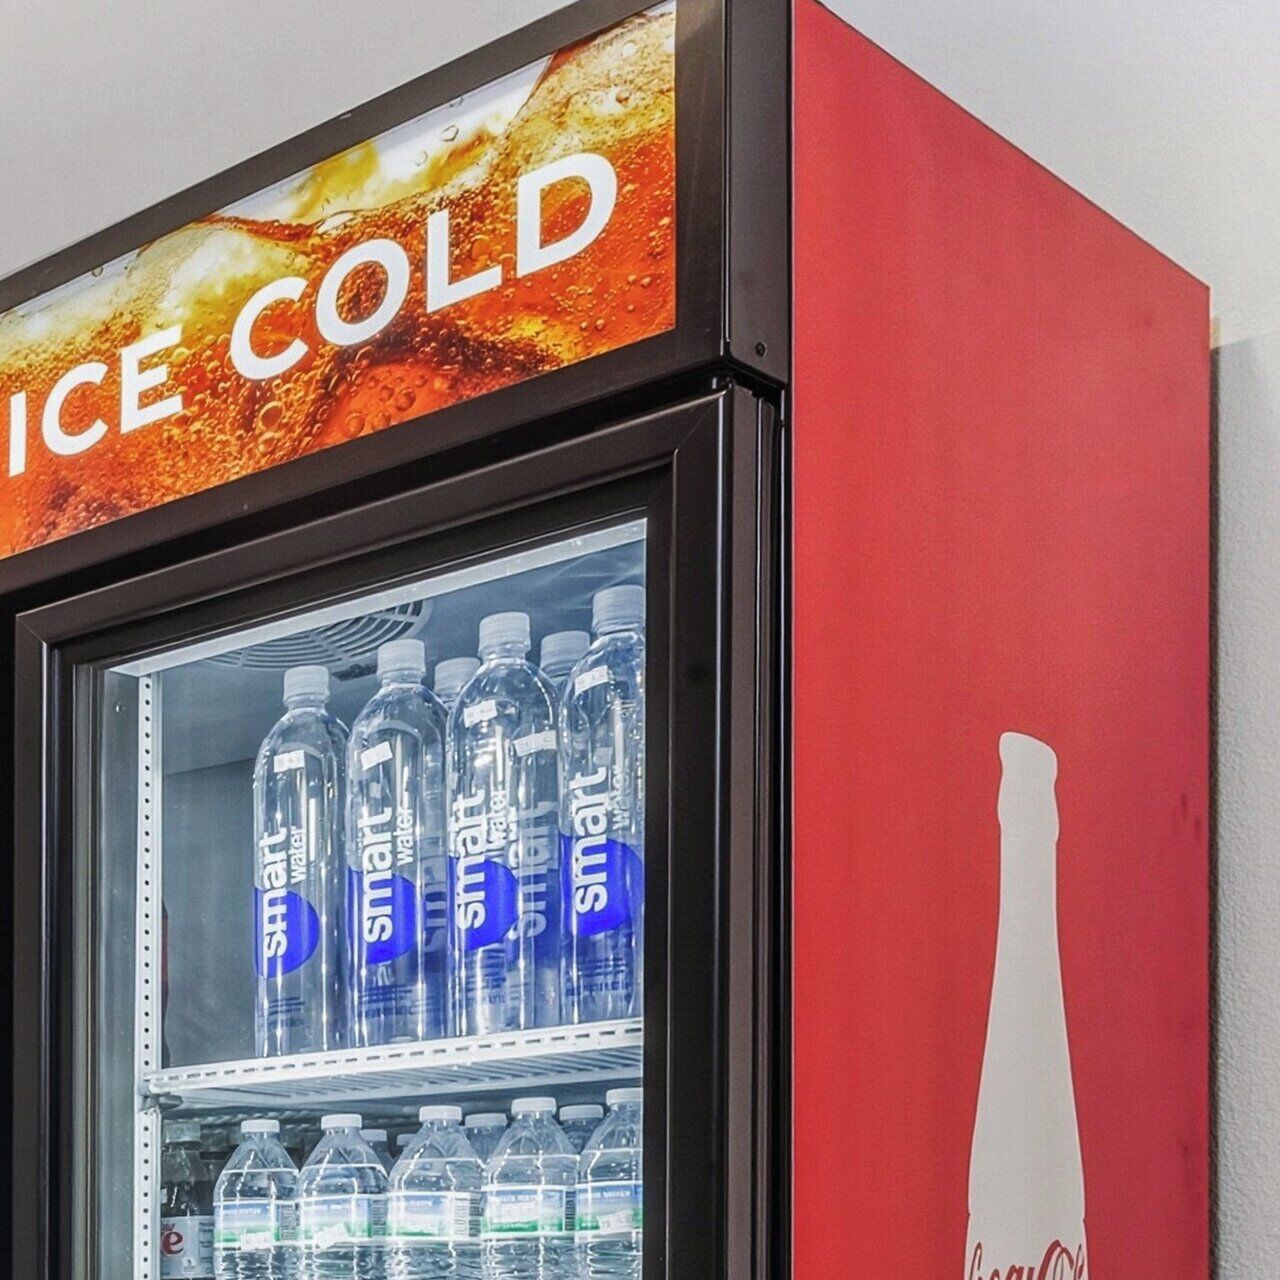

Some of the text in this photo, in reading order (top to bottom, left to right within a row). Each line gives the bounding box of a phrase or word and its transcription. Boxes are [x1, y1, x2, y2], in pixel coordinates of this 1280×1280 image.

[5, 152, 617, 477] ICE COLD
[259, 827, 288, 959] smart
[290, 825, 307, 884] water
[357, 806, 393, 944] smart
[392, 800, 414, 866] water
[450, 788, 486, 931] smart
[568, 766, 607, 914] smart
